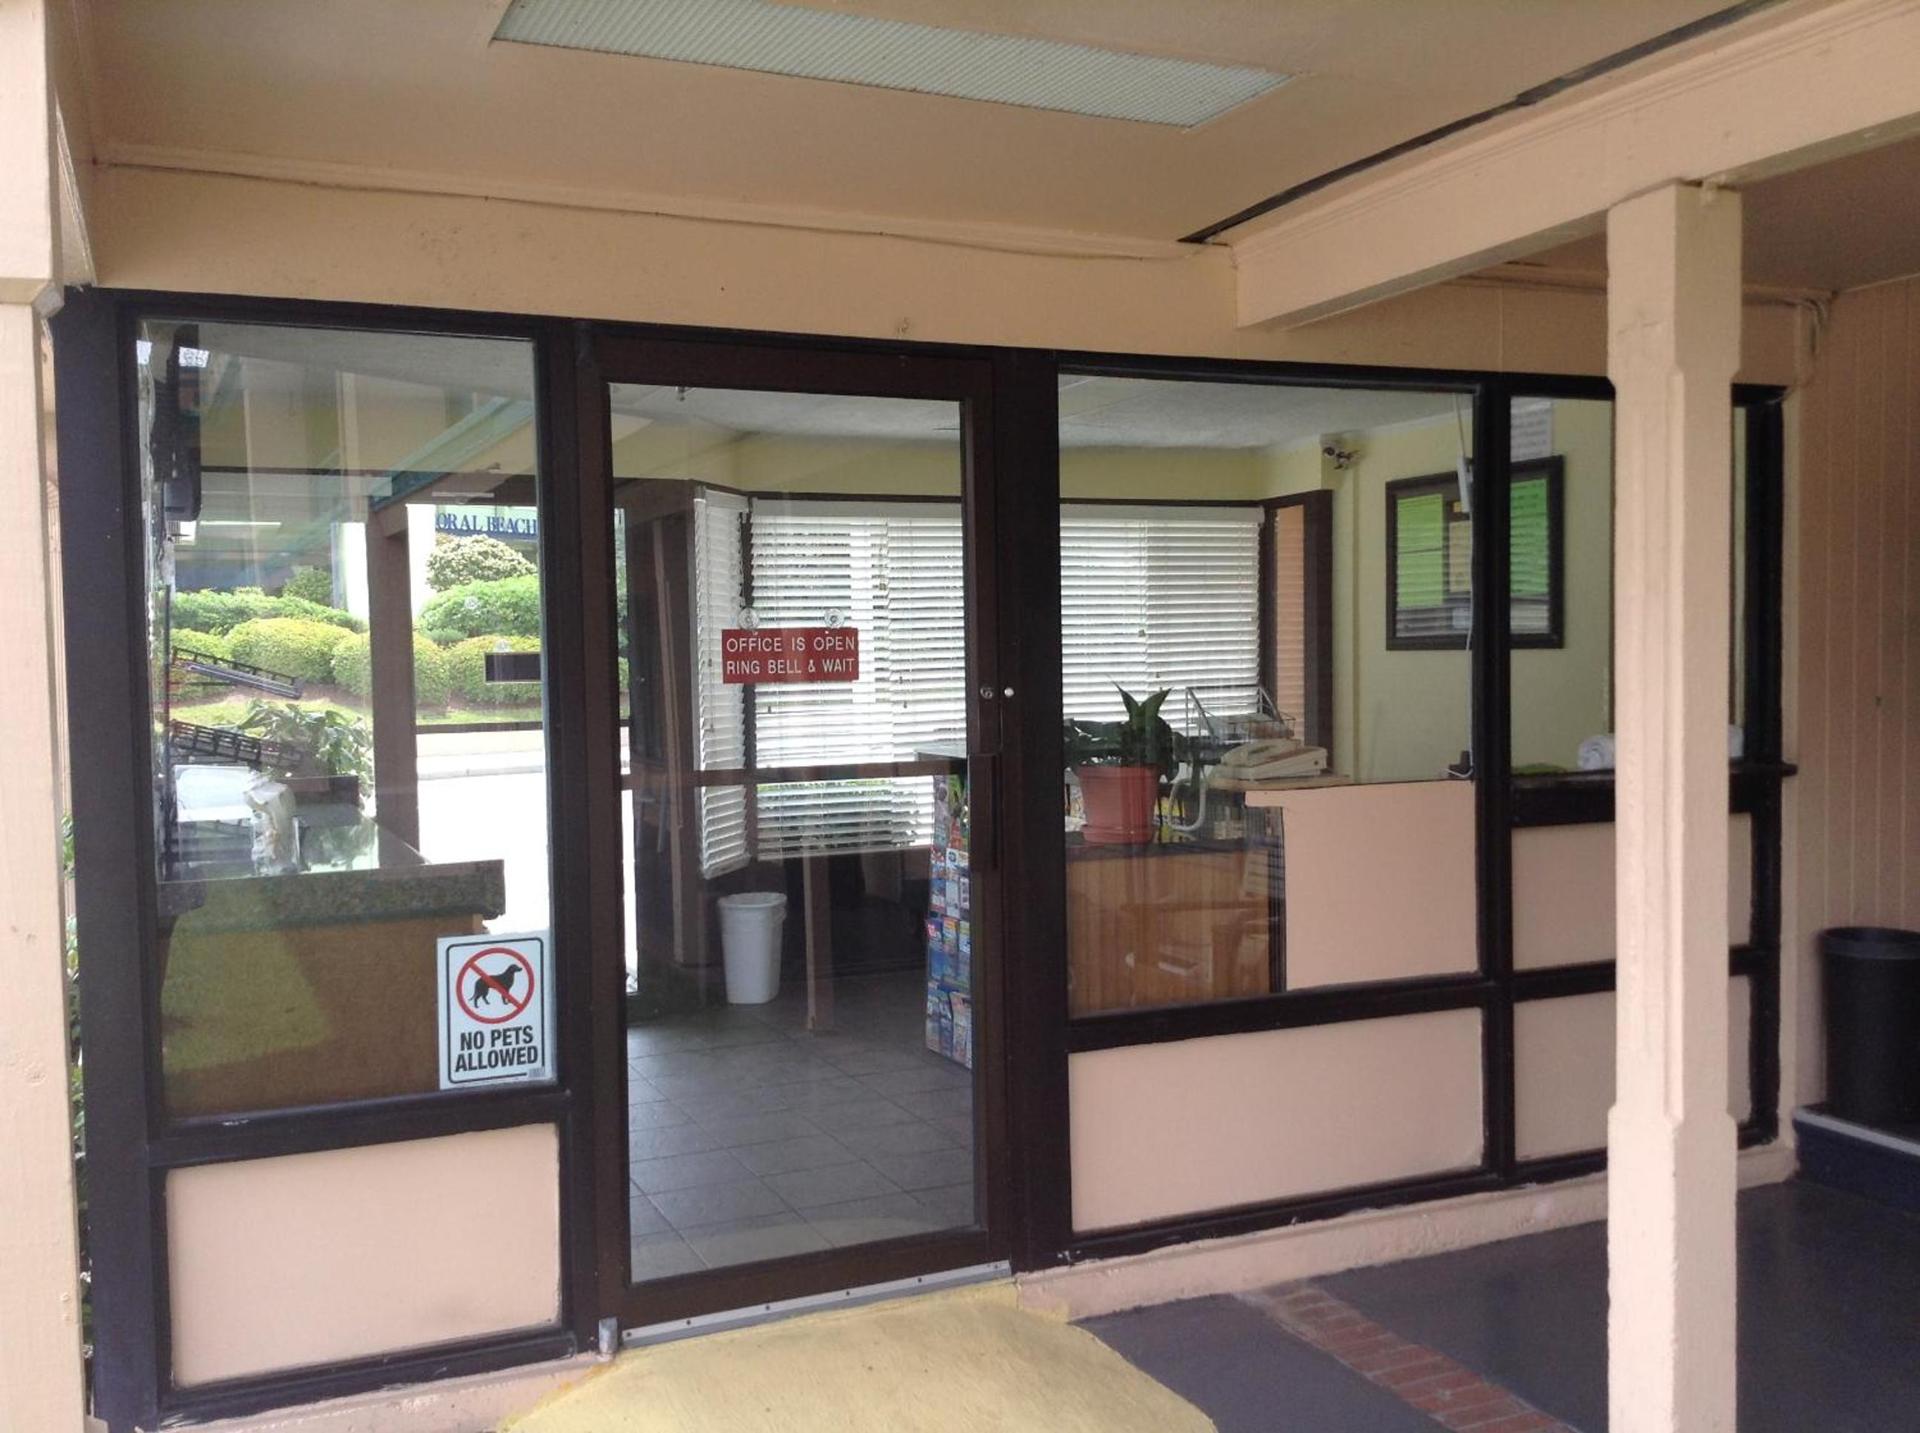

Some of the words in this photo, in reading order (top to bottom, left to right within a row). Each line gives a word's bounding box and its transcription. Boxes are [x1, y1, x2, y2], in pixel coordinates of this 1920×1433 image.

[436, 512, 482, 532] ORAL
[486, 516, 537, 536] BEACH
[726, 637, 783, 653] OFFICE
[791, 636, 806, 652] IS
[813, 636, 855, 652] OPEN
[726, 660, 760, 675] RING
[767, 659, 802, 674] BELL
[807, 659, 816, 673] &
[822, 658, 855, 673] WAIT
[460, 1030, 485, 1051] NO
[490, 1025, 534, 1048] PETS
[455, 1046, 538, 1072] ALLOWED
